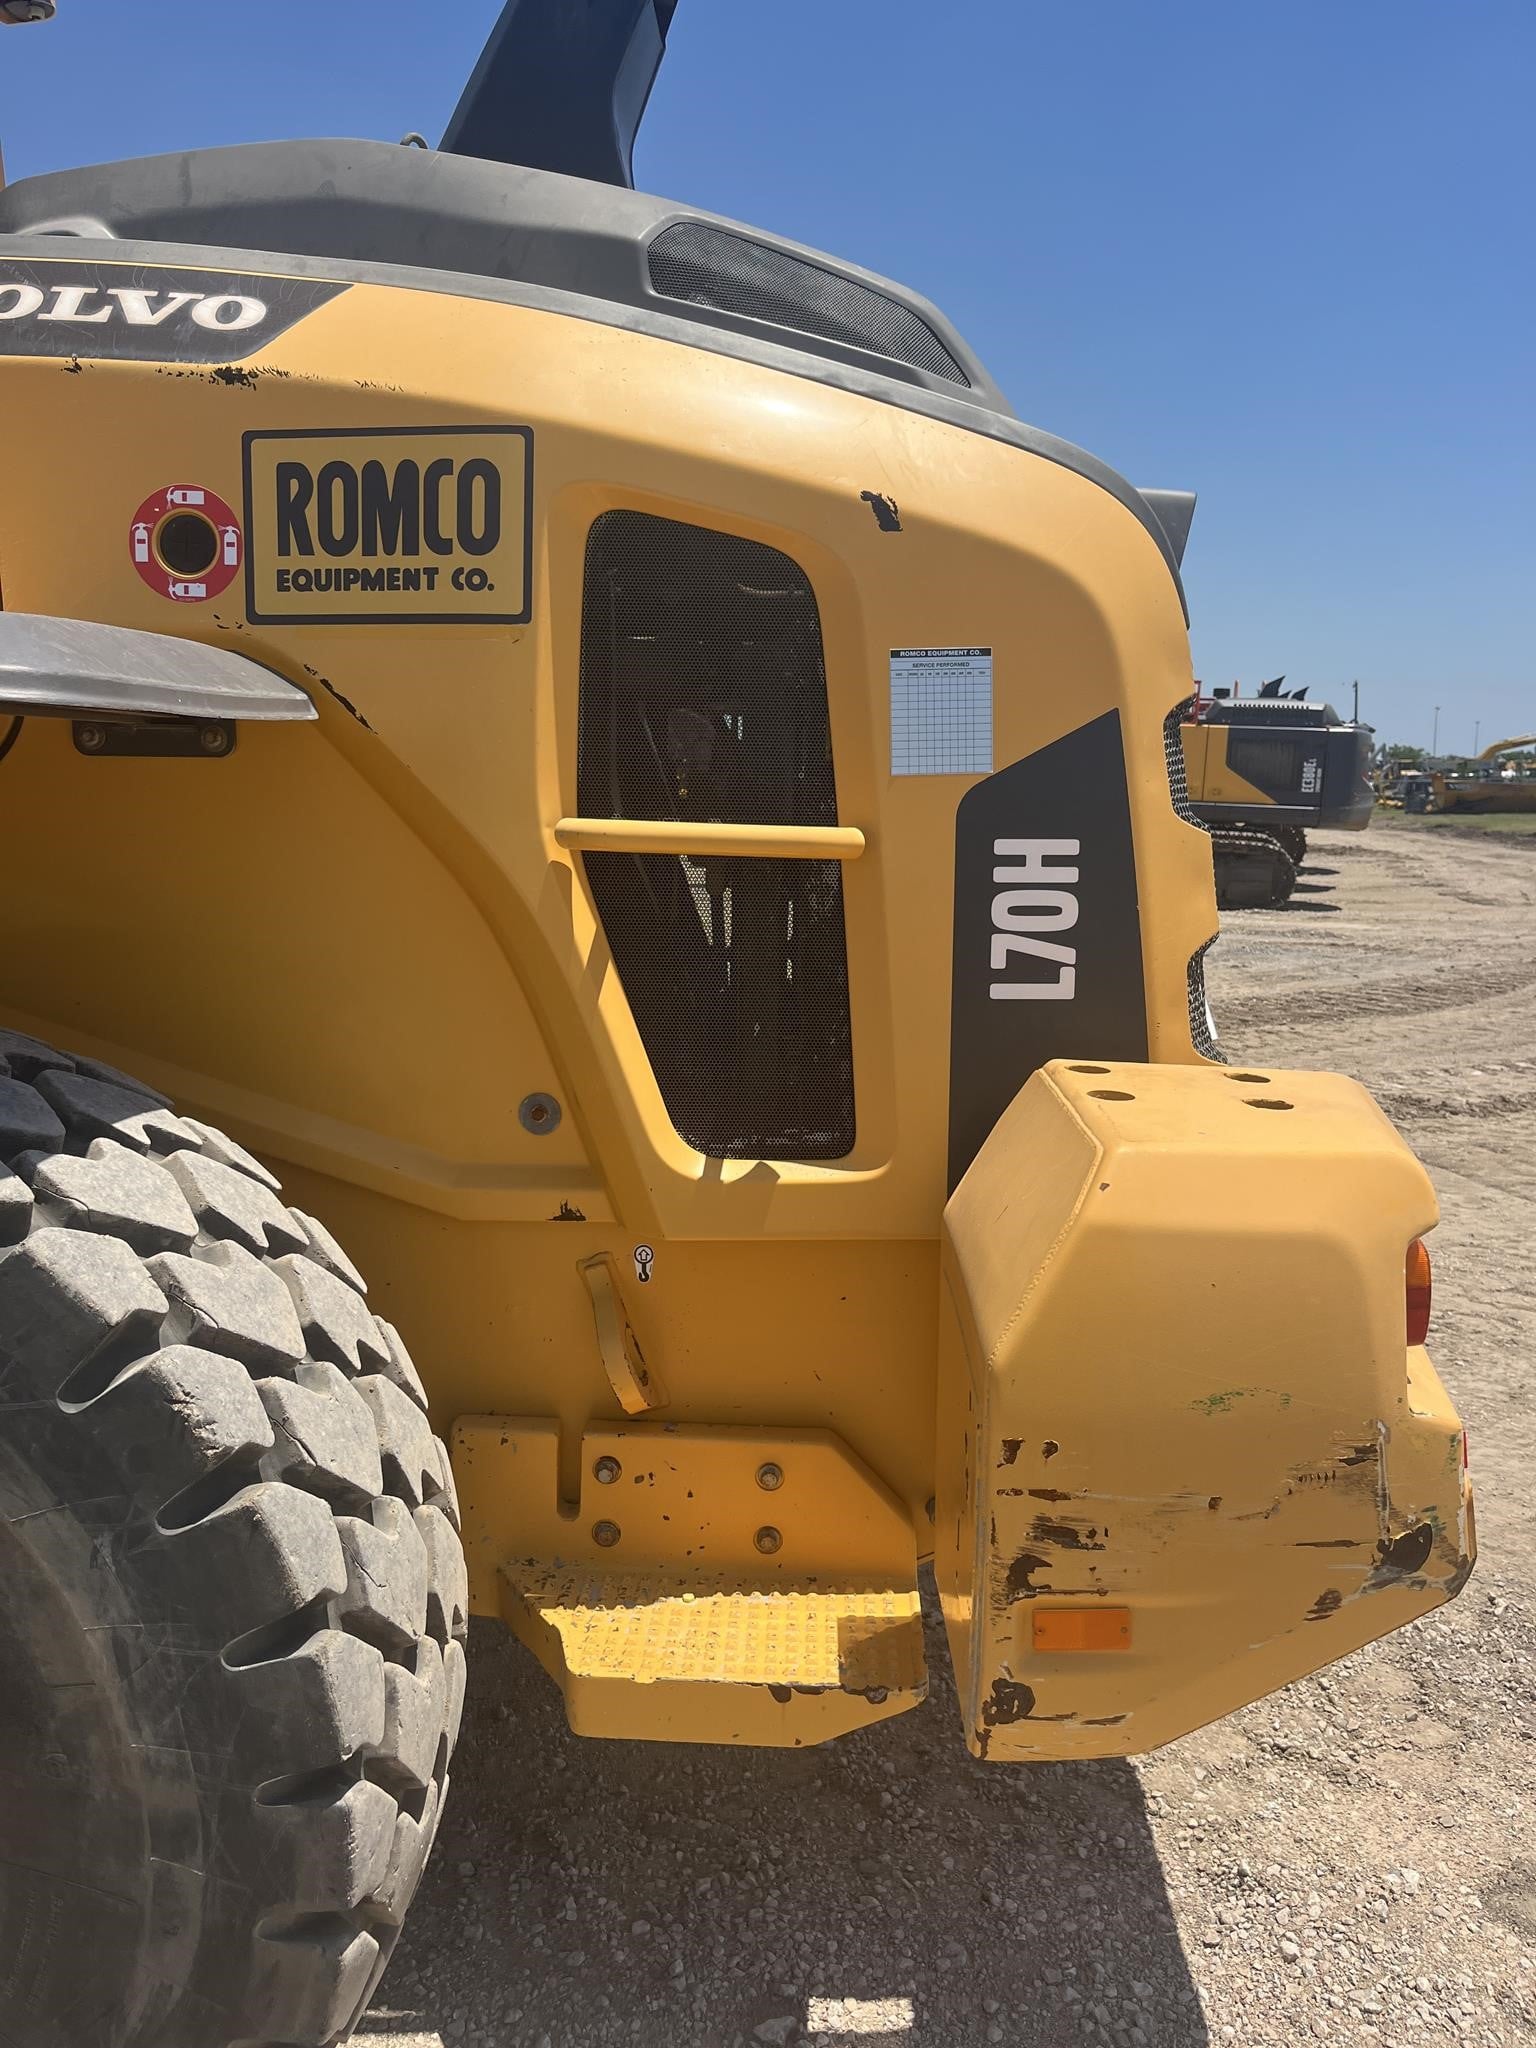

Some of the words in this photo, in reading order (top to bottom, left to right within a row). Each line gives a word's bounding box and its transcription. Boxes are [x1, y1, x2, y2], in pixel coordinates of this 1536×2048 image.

[276, 458, 501, 557] ROMCO
[276, 568, 439, 592] EQUIPMENT
[451, 566, 495, 592] CO.
[927, 649, 968, 657] EQUIPMENT
[936, 661, 970, 669] PERFORMED
[989, 838, 1080, 1000] L70H
